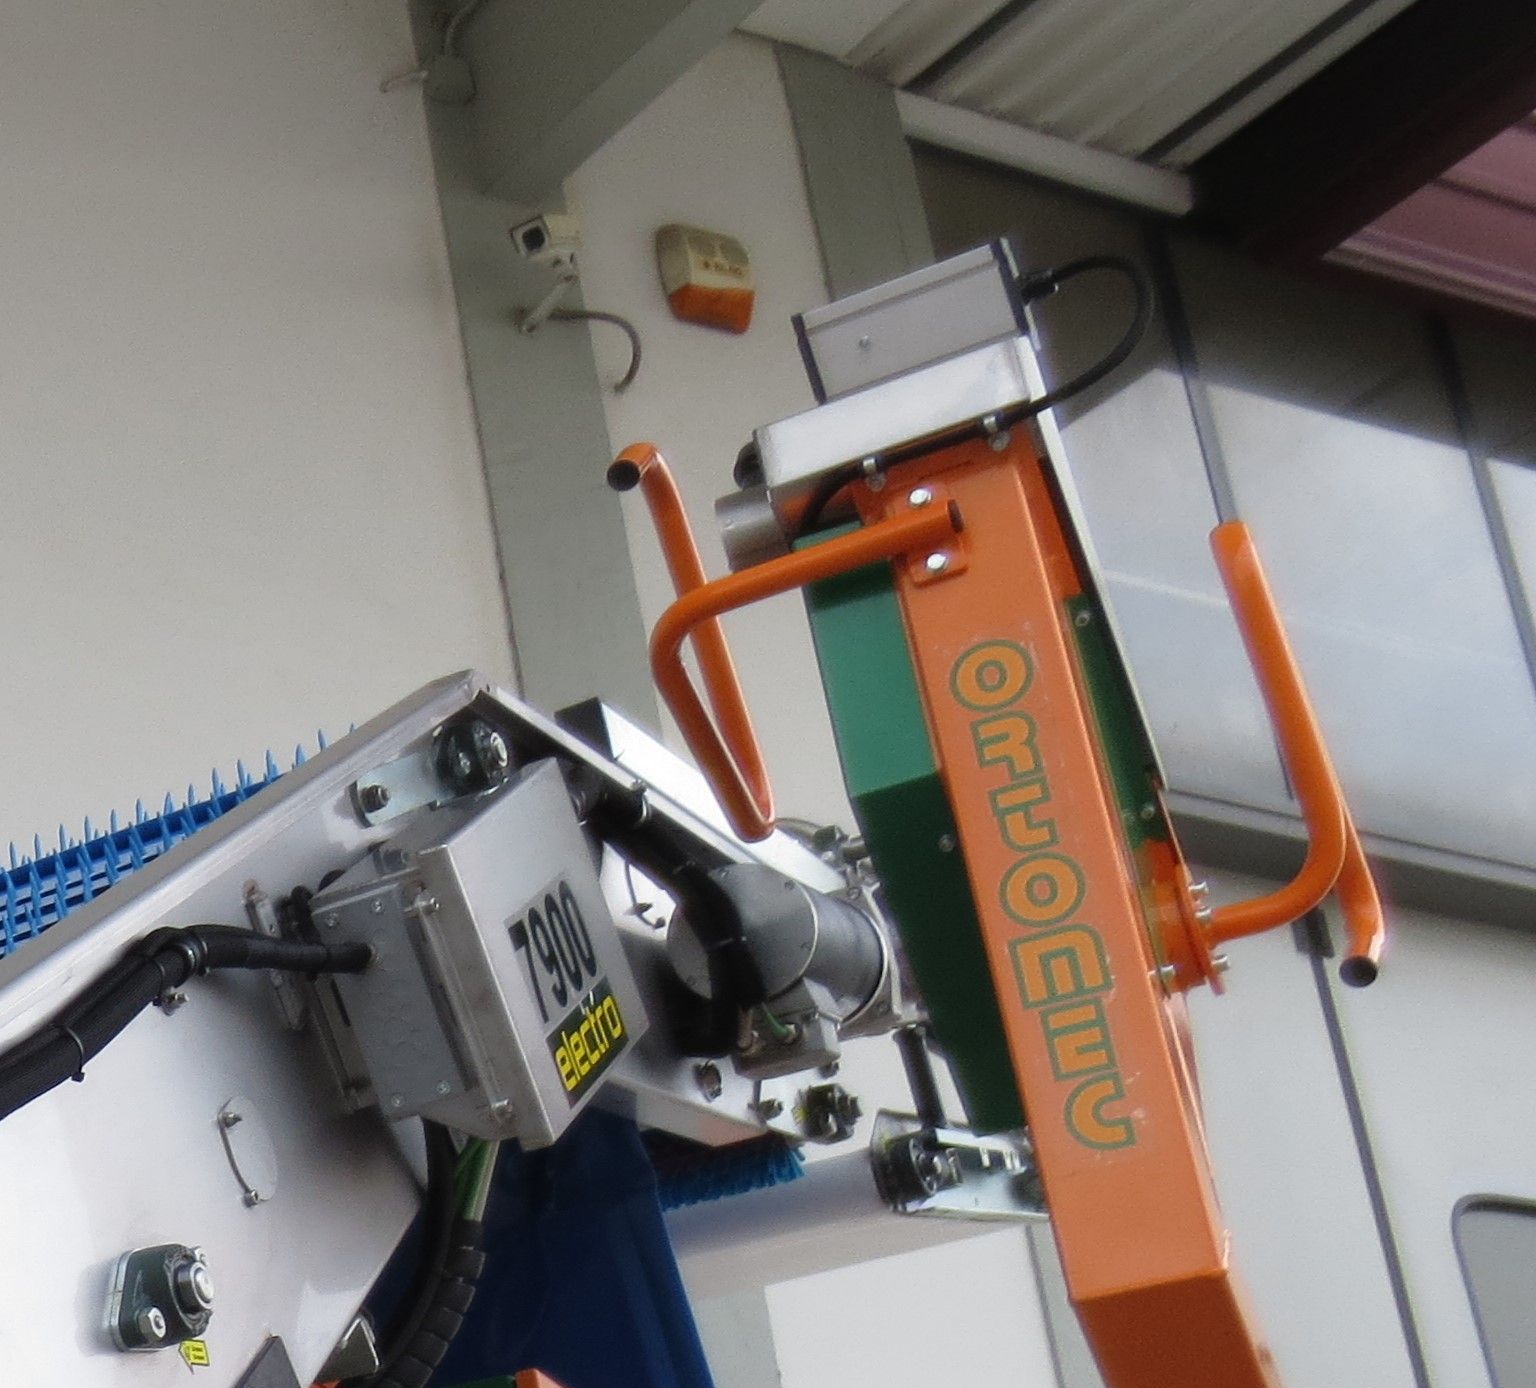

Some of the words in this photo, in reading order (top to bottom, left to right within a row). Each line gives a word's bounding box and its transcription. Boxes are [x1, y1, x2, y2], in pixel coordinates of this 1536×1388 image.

[507, 880, 597, 1024] 7900
[949, 639, 1137, 1150] ORTOMEC
[554, 994, 625, 1091] electro
